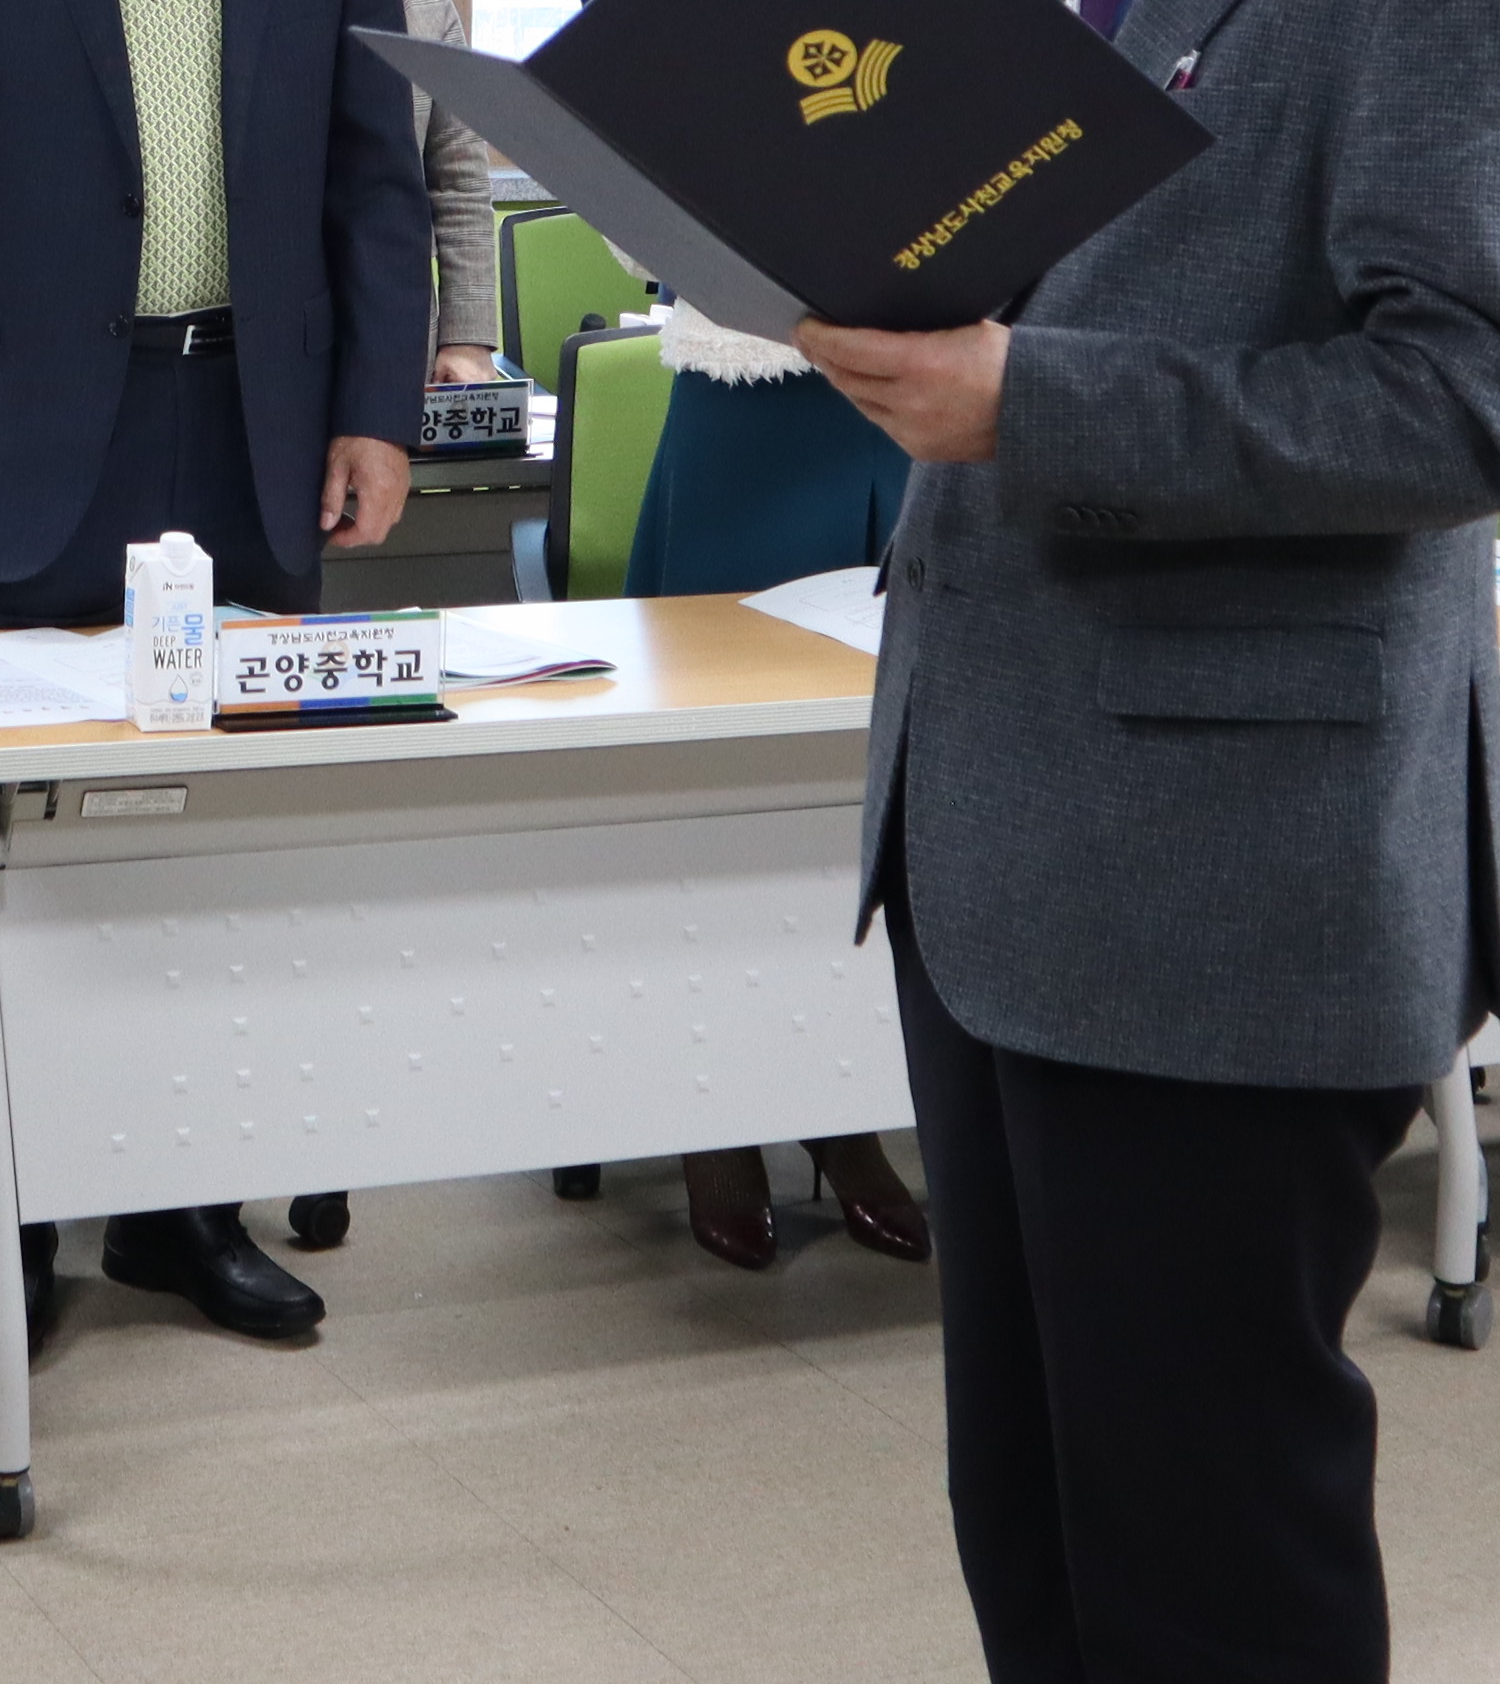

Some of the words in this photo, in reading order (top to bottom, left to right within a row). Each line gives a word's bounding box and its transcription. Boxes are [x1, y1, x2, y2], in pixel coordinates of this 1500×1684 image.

[893, 118, 1083, 269] 경상남도사천교육지원청
[153, 635, 176, 647] DEEP
[181, 613, 206, 646] 물
[267, 627, 395, 645] 경상남도사천교육지원청
[153, 648, 202, 670] WATER
[235, 649, 424, 694] 곤양중학교
